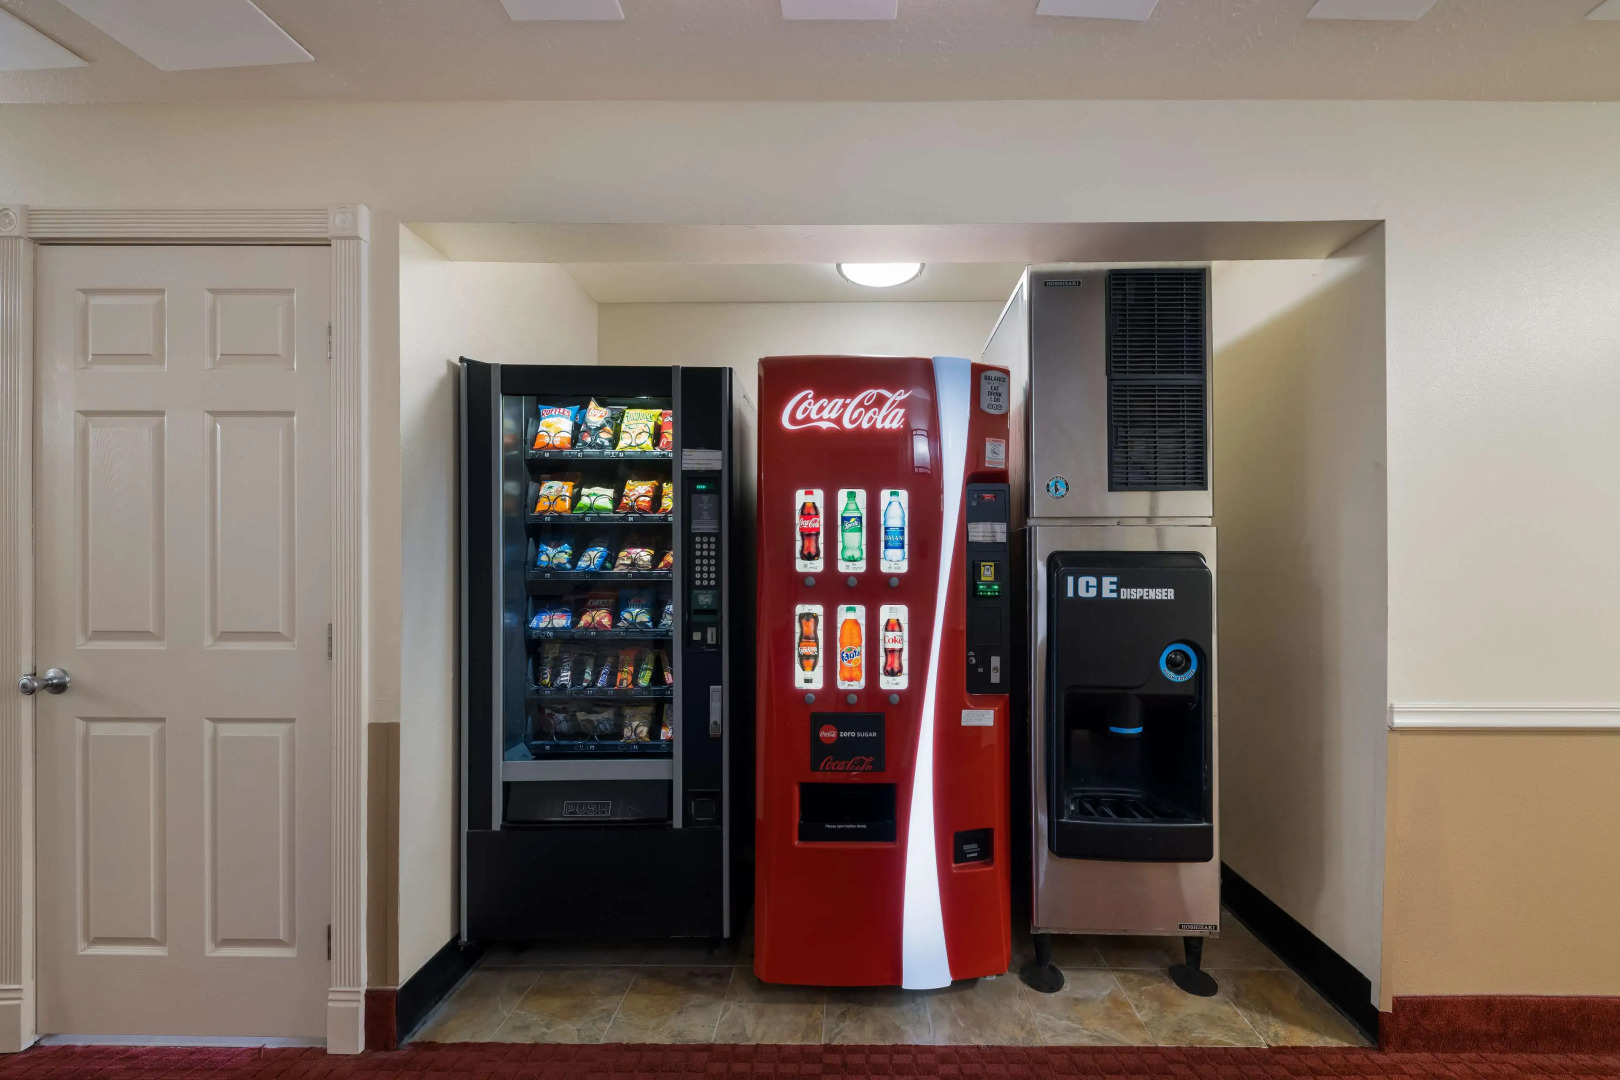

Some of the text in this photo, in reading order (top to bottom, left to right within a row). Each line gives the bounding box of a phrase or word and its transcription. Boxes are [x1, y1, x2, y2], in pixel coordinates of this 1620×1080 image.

[541, 408, 571, 417] RUFFLES
[782, 389, 912, 430] Coca-Cola
[1067, 575, 1175, 600] ICE DISPENSER
[565, 803, 609, 815] PUSH
